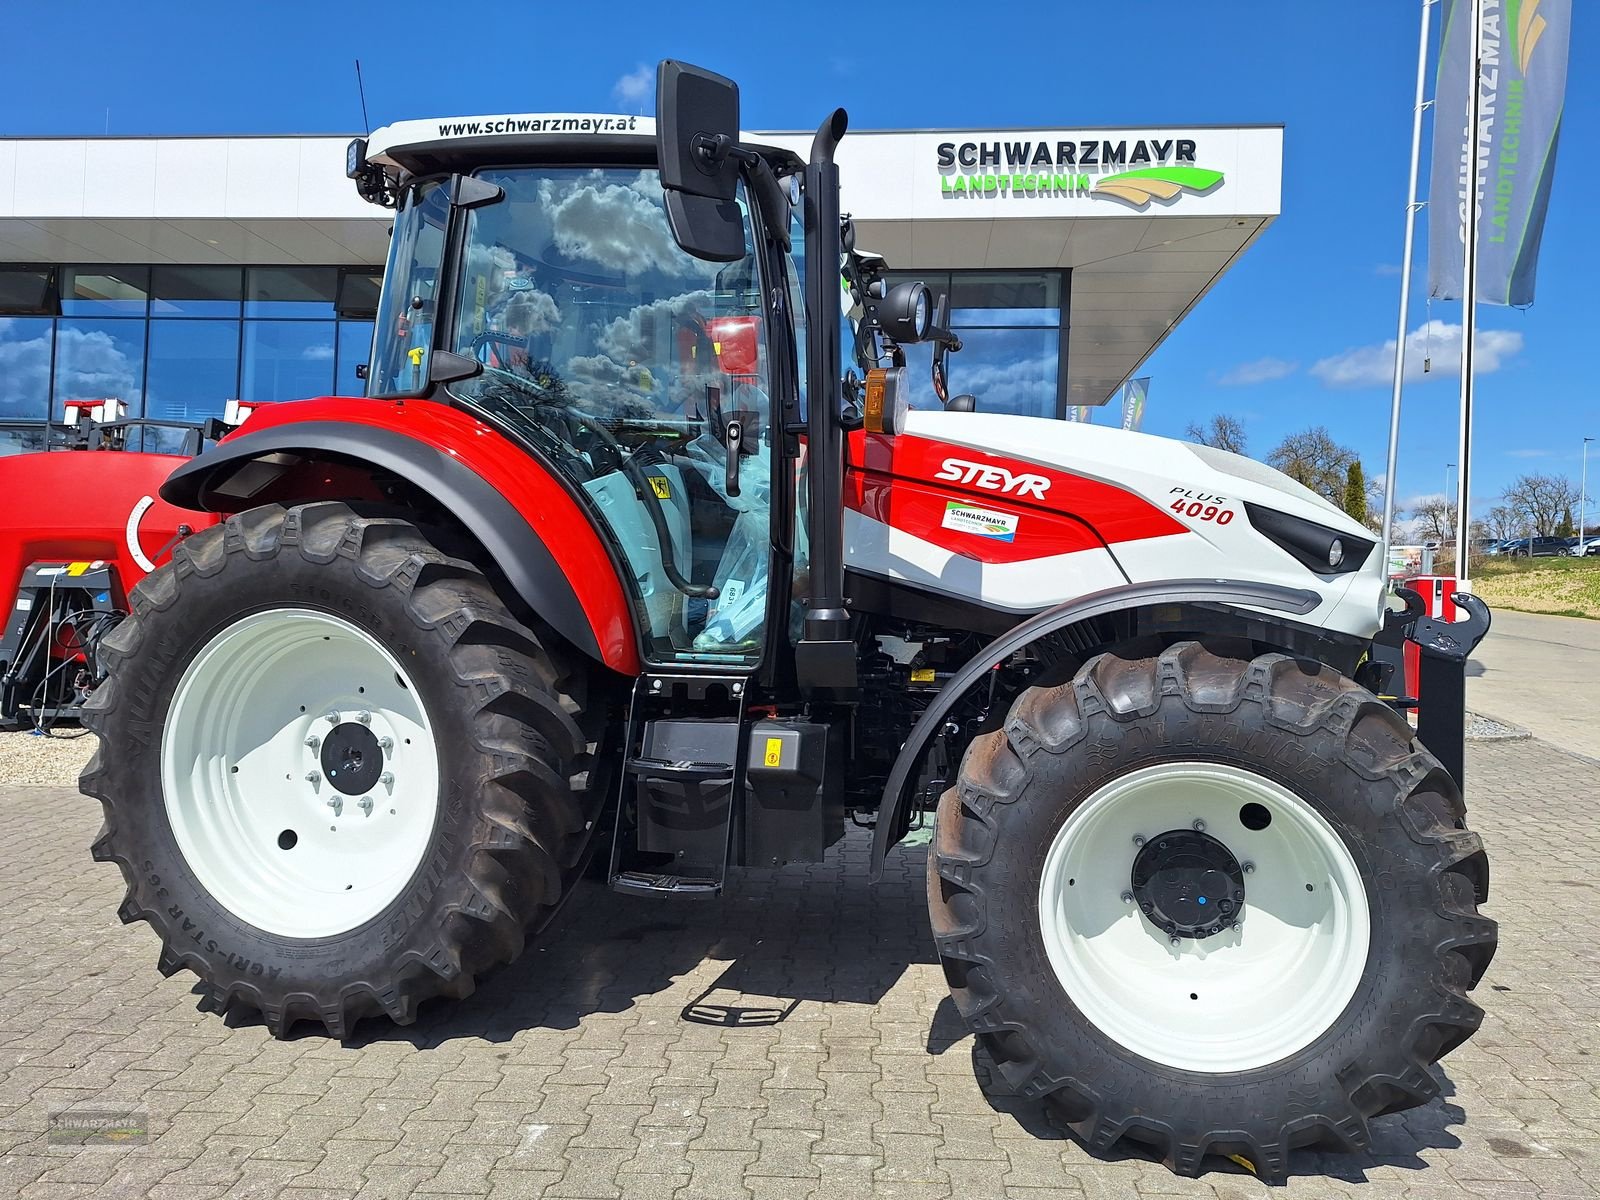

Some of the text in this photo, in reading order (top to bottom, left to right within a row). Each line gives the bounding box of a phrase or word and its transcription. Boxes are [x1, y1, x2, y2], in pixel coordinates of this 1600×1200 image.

[439, 116, 637, 136] www.schwarzmayr.at
[937, 140, 1197, 166] SCHWARZMAYR
[1488, 79, 1525, 243] LANDTECHNIK
[941, 174, 1091, 192] LANDTECHNIK
[934, 457, 1052, 500] STEYR
[1169, 487, 1228, 505] PLUS
[951, 509, 1007, 526] SCHWARZMAYR
[1169, 498, 1235, 526] 4090
[142, 860, 283, 980] AGRI-STAR 365
